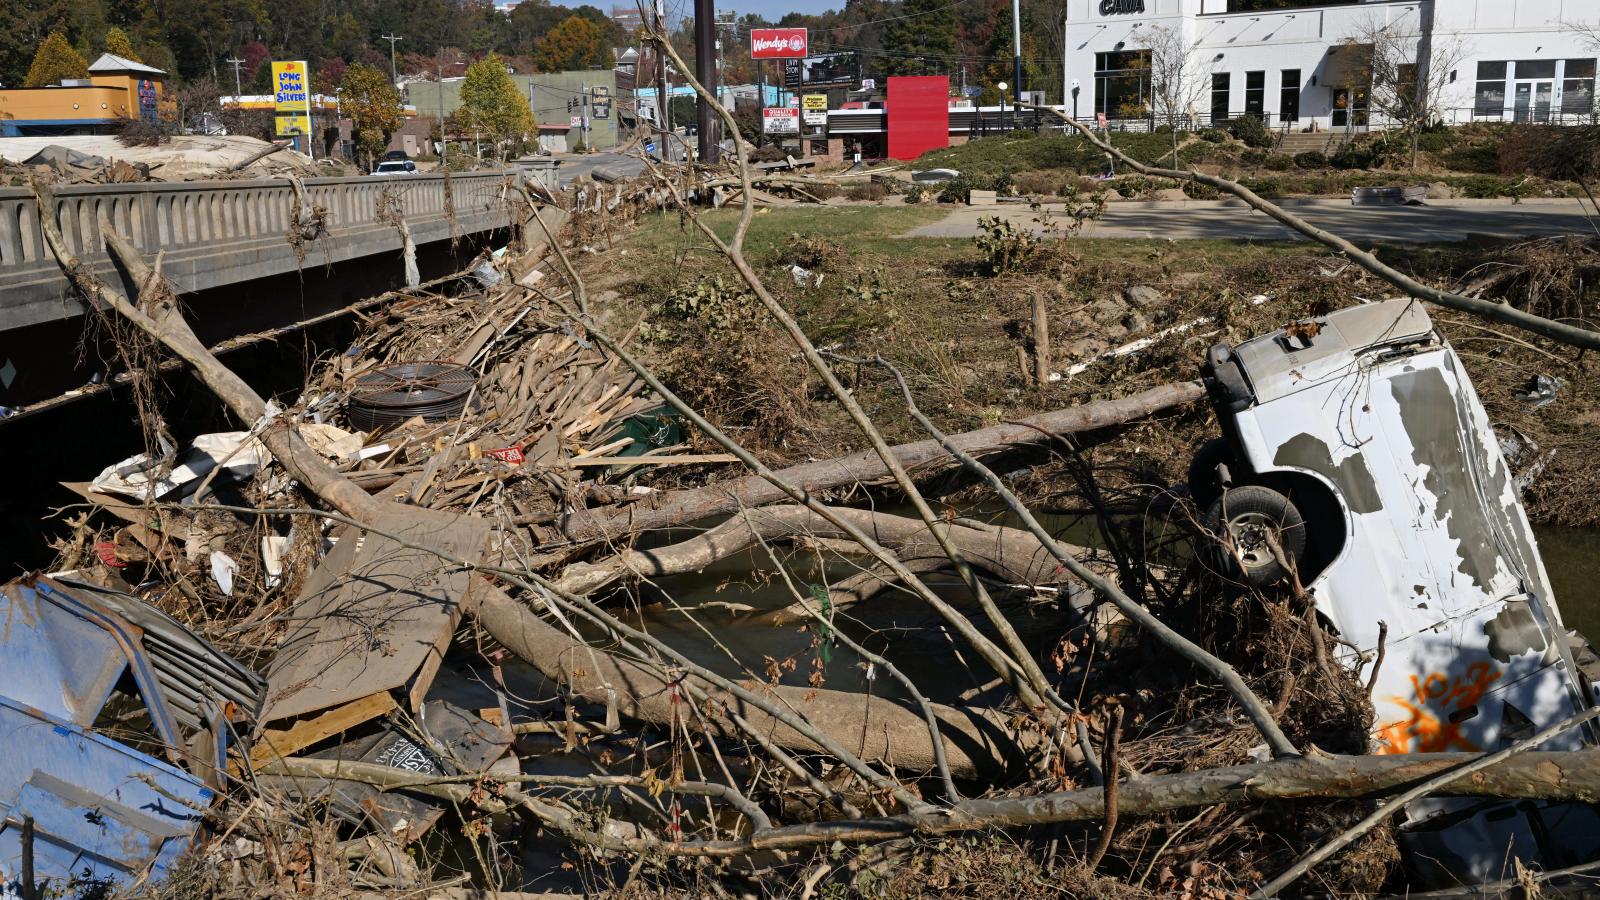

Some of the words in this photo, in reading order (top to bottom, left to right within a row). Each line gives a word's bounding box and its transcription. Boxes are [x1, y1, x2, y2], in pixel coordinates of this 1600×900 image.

[1099, 0, 1145, 15] CAVA
[753, 35, 788, 52] Wendy's
[394, 743, 416, 763] OMPANY
